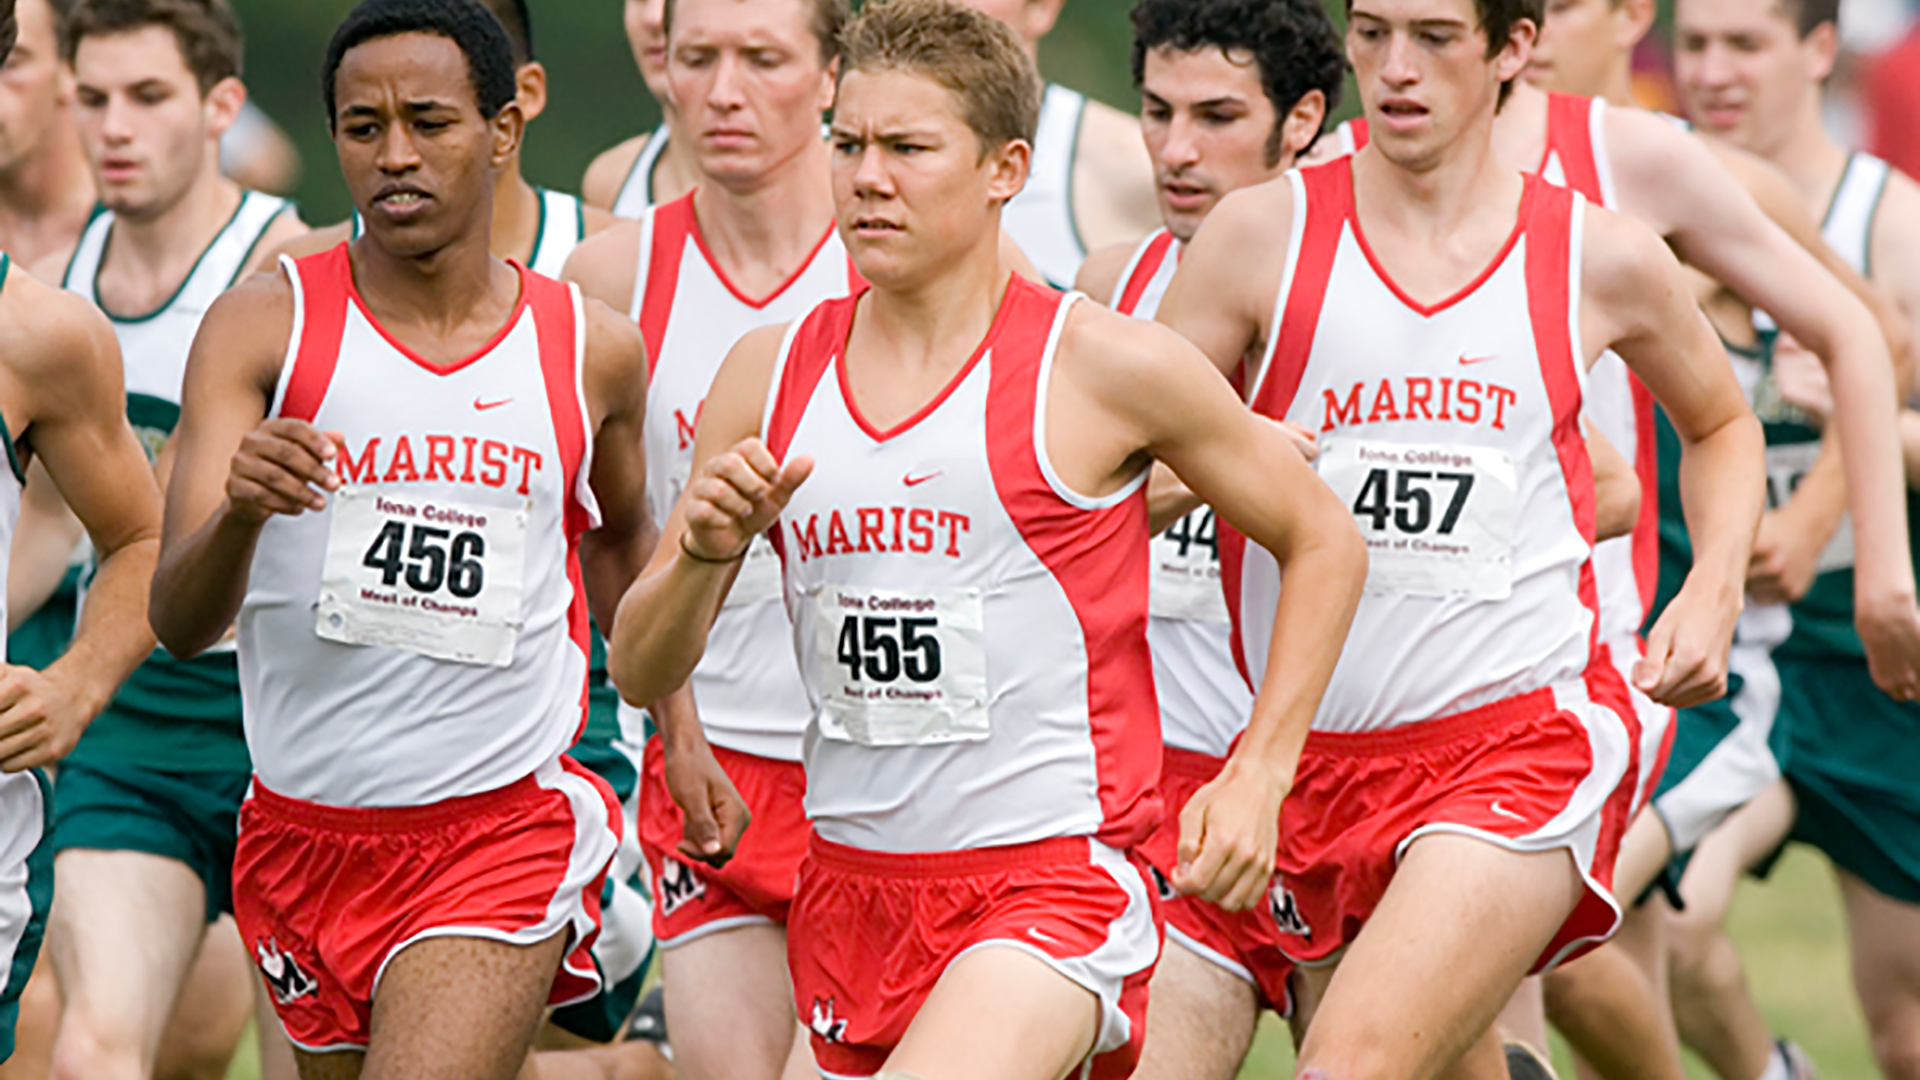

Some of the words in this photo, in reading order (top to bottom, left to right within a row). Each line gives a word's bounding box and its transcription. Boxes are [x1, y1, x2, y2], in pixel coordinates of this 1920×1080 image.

[1320, 377, 1516, 431] MARIST
[335, 435, 543, 496] MARIST
[1403, 449, 1472, 467] College
[375, 496, 417, 517] Iona
[422, 504, 487, 528] College
[1352, 468, 1475, 535] 457
[791, 506, 970, 562] MARIST
[1411, 538, 1470, 555] Champs
[362, 519, 485, 599] 456
[360, 588, 398, 605] Meet
[401, 595, 418, 607] of
[420, 597, 478, 618] Champs
[867, 594, 936, 613] College
[837, 615, 942, 683] 455
[885, 686, 944, 702] Champs
